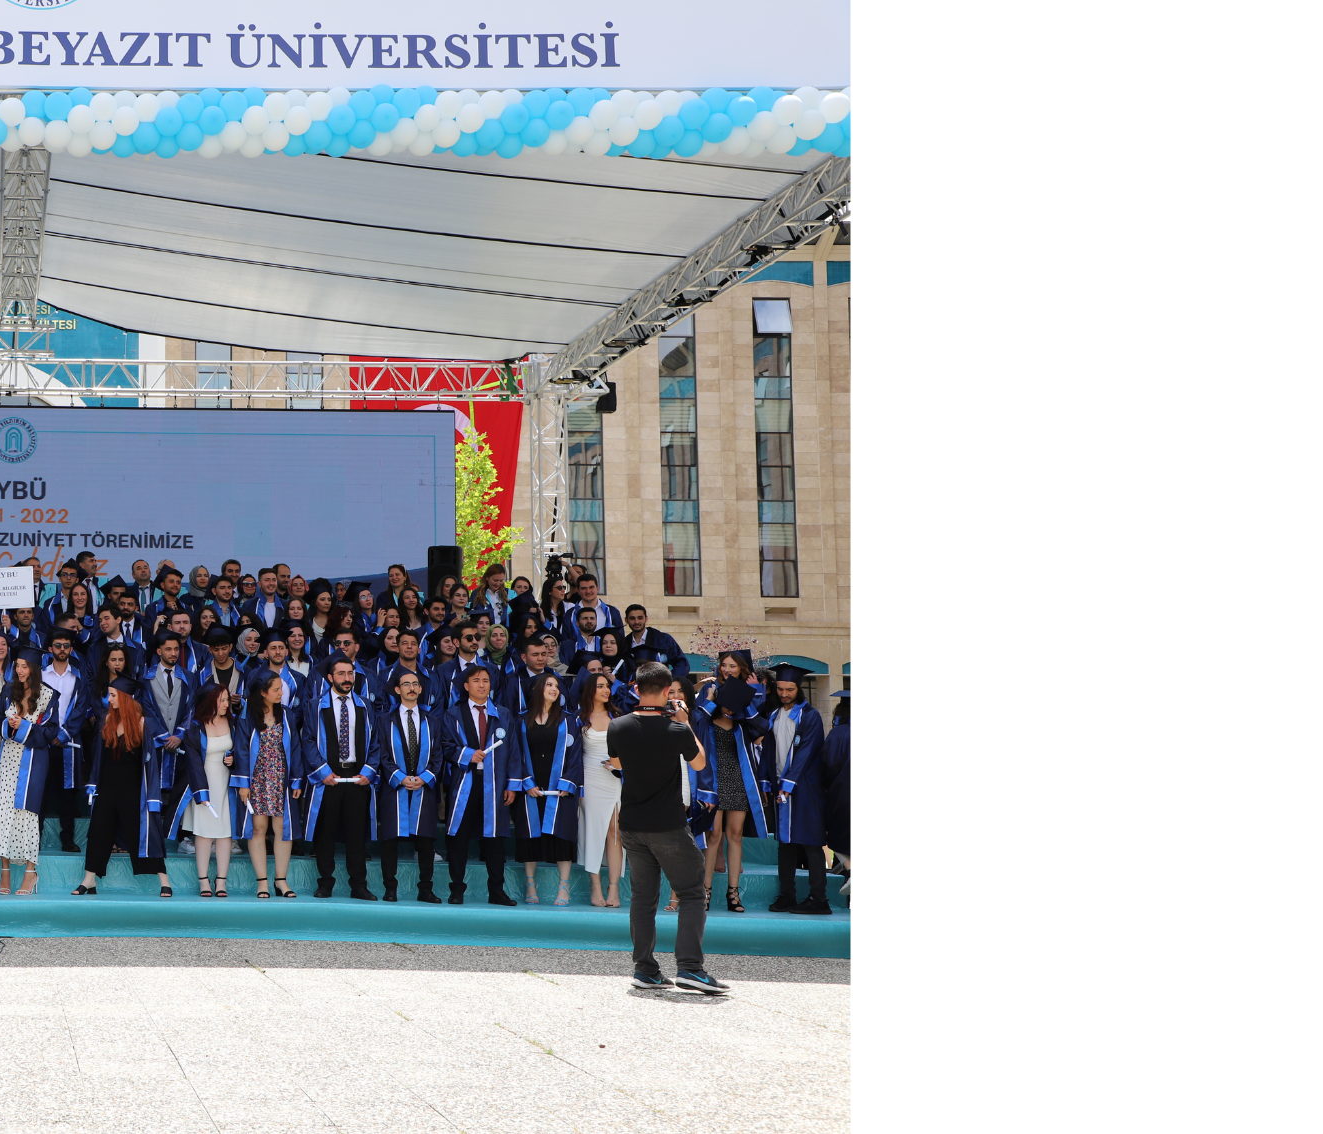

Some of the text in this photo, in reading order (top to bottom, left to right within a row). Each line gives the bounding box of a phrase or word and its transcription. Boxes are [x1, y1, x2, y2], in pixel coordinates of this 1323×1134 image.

[225, 21, 621, 70] ÜNİVERSİTESİ
[20, 508, 69, 524] 2022
[80, 531, 194, 549] TÖRENİMİZE
